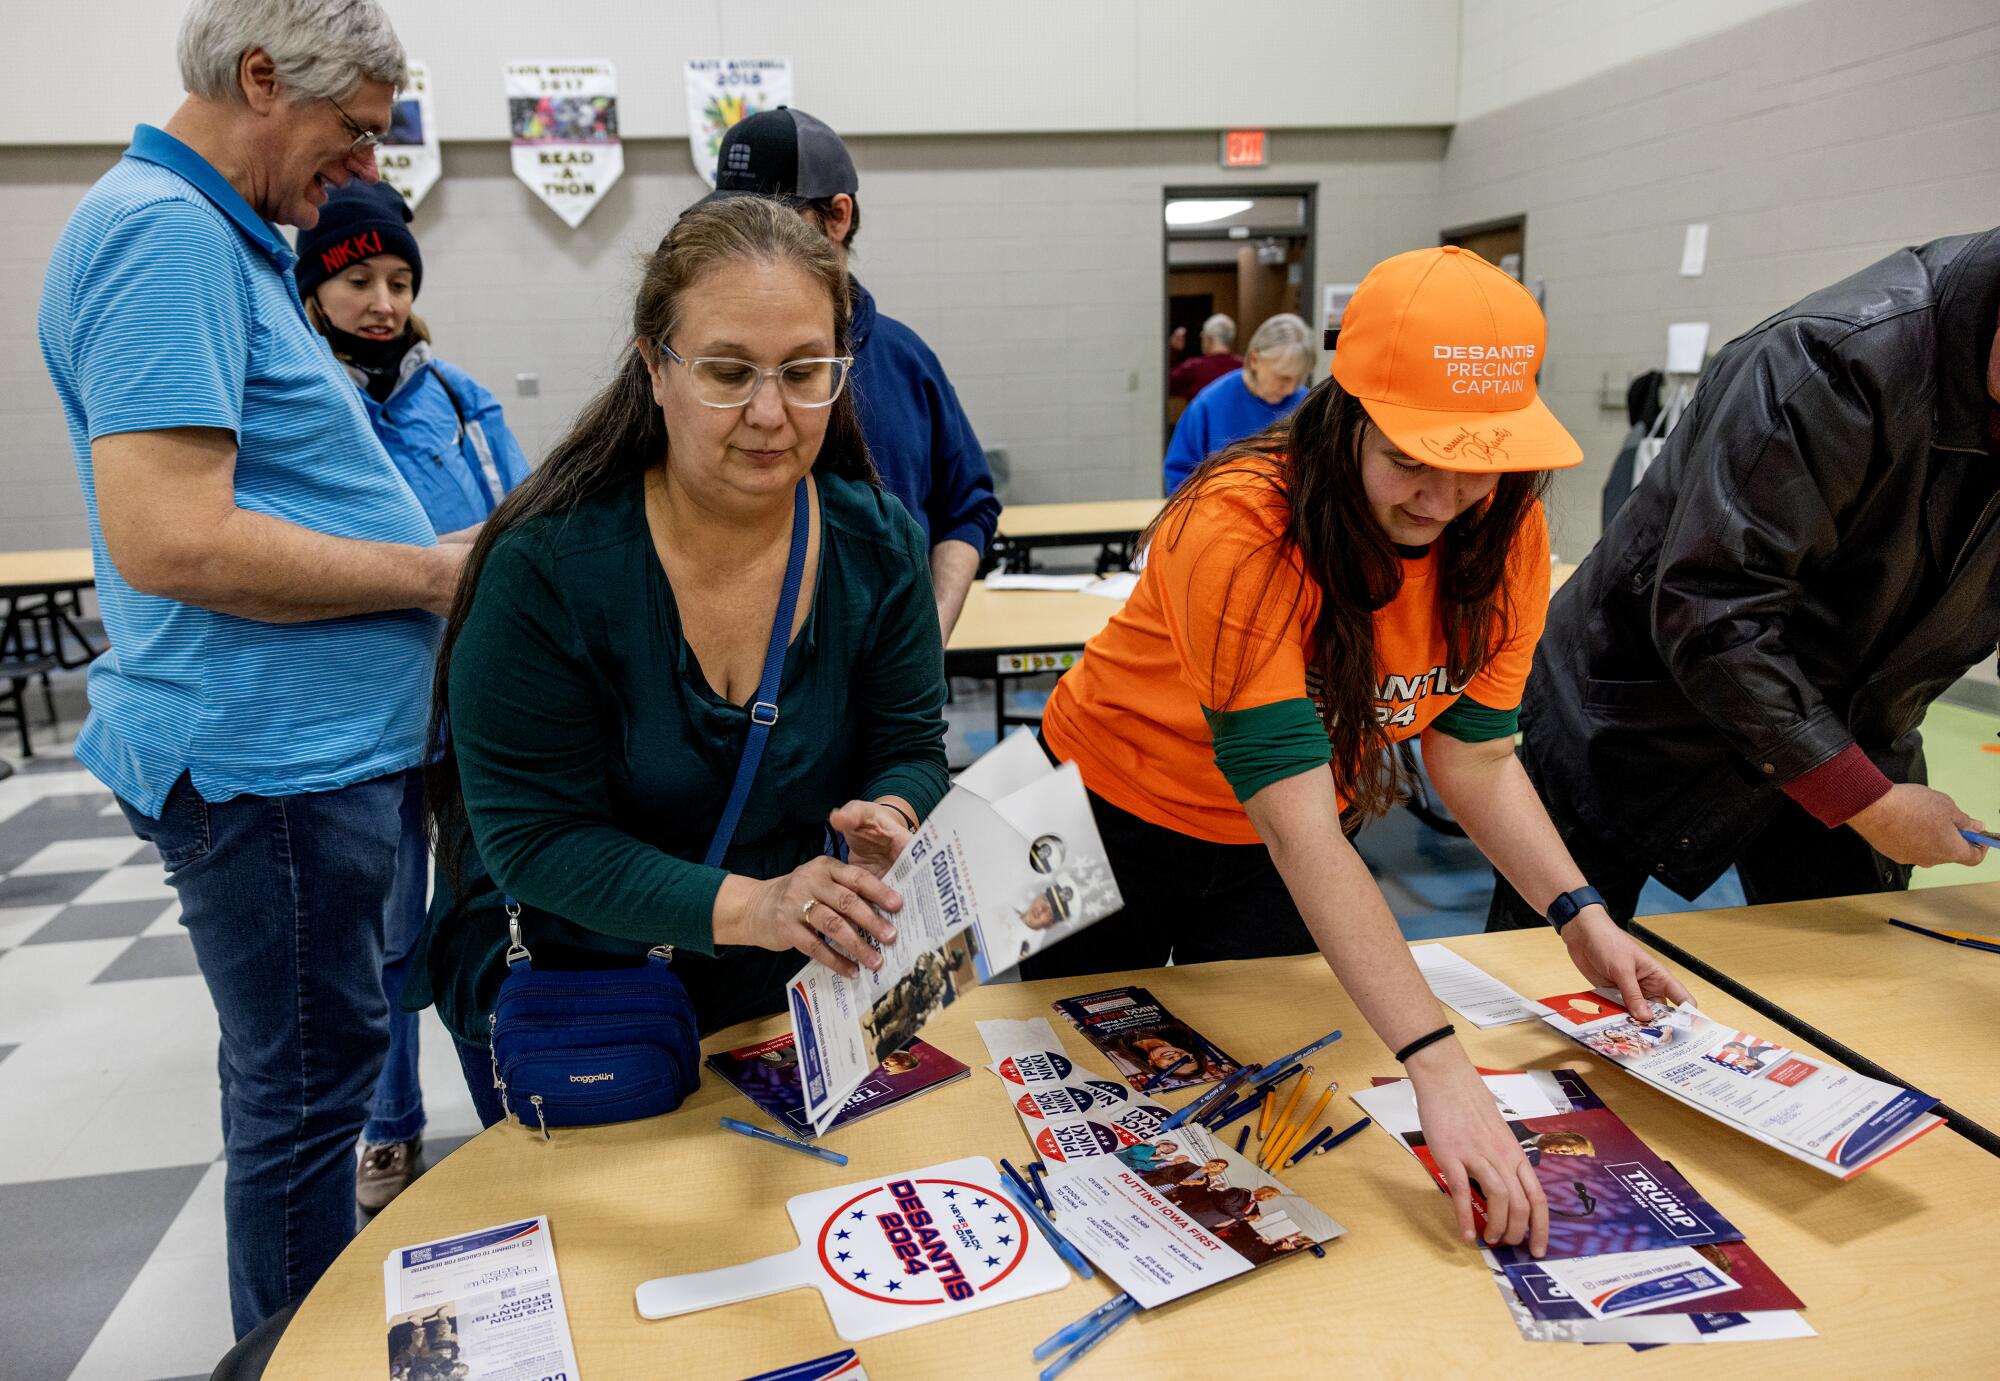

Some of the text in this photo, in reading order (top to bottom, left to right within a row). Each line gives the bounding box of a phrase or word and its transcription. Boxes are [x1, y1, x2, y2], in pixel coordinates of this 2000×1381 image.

[540, 80, 584, 90] 2017
[717, 73, 762, 86] 2018
[538, 151, 594, 165] READ
[542, 182, 596, 195] THON
[321, 230, 383, 273] NIKKI
[1433, 344, 1536, 360] DESANTIS
[1447, 361, 1528, 377] PRECINCT
[1452, 379, 1524, 394] CAPTAIN
[931, 850, 962, 928] COUNTRY
[946, 844, 956, 865] NOT
[959, 895, 969, 916] BUT
[1083, 1010, 1127, 1026] HALEY
[1124, 1004, 1160, 1016] NIKKI
[1015, 1056, 1036, 1077] PICK
[1030, 1054, 1056, 1081] NIKKI
[1661, 1062, 1699, 1080] LEADER
[569, 1072, 614, 1084] baggallini
[1033, 1092, 1056, 1112] PICK
[1049, 1089, 1077, 1114] NIKKI
[1114, 1115, 1155, 1140] PICK
[1053, 1126, 1080, 1154] PICK
[1070, 1124, 1100, 1157] NIKKI
[1088, 1177, 1104, 1190] OVER
[1056, 1188, 1079, 1209] TO CHINA
[1062, 1185, 1088, 1207] STOOD UP
[1627, 1170, 1697, 1228] TRUMP
[1118, 1172, 1162, 1207] PUTTING
[1158, 1206, 1189, 1230] IOWA
[1187, 1228, 1222, 1252] FIRST
[948, 1203, 983, 1251] NEVER BACK
[952, 1224, 972, 1249] DOWN
[1086, 1216, 1130, 1251] CAUCUSES FIRST
[1101, 1219, 1131, 1243] KEPT IOWA
[876, 1212, 930, 1276] 2024
[886, 1179, 976, 1302] DESANTIS
[1179, 1253, 1202, 1271] BILLION
[471, 1298, 552, 1324] DESANTIS'
[498, 1292, 551, 1310] STORY.
[490, 1304, 554, 1325] IT'S RON
